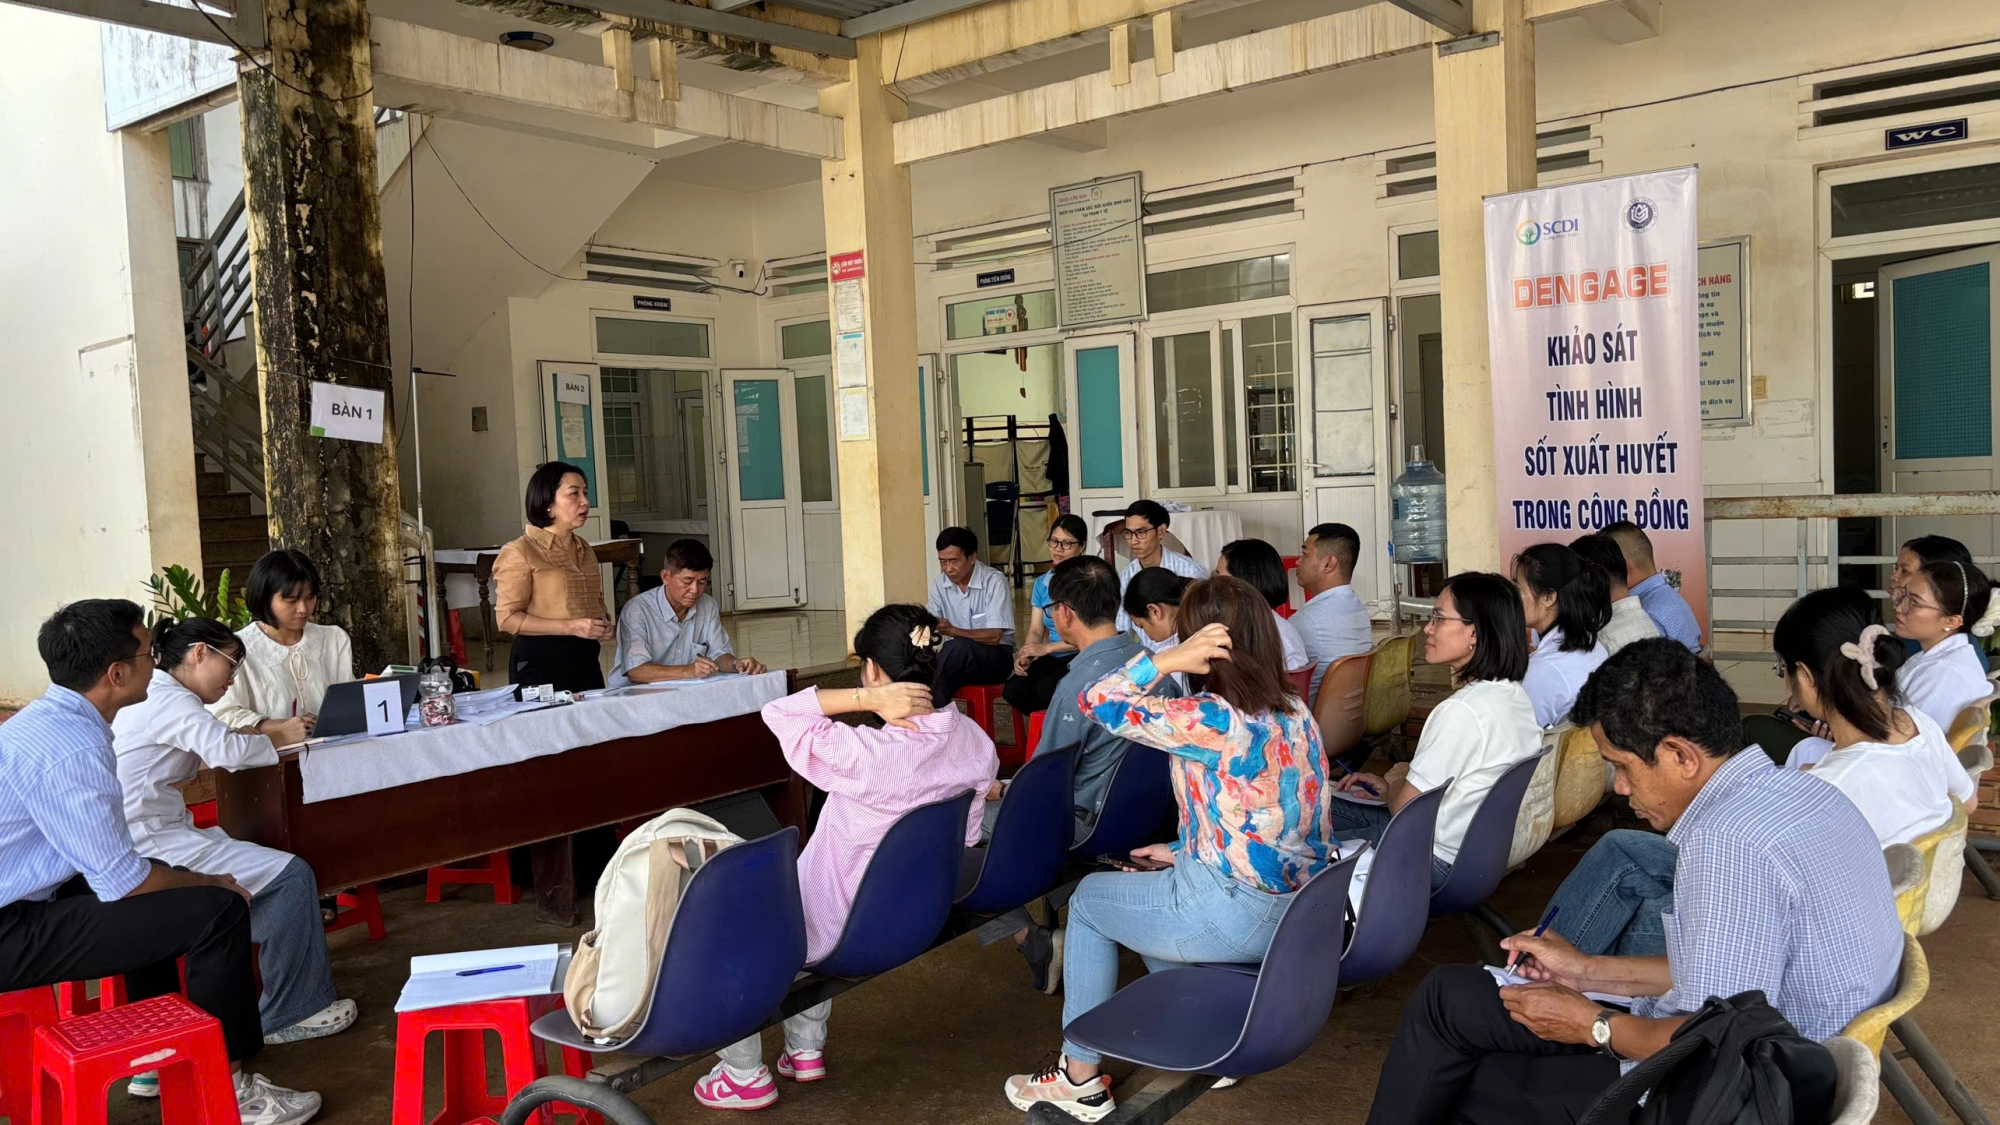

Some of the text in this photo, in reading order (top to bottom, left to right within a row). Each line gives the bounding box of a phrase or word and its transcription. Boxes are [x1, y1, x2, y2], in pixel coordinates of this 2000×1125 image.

[1895, 126, 1957, 142] WC
[1543, 218, 1578, 235] SCDI
[1514, 263, 1669, 309] DENGAGE
[1709, 274, 1732, 285] HÀNG
[1548, 323, 1637, 366] KHẢO SÁT
[566, 382, 579, 392] BÀN
[332, 402, 372, 420] BÀN 1
[1546, 380, 1642, 421] TÌNH HÌNH
[1525, 431, 1678, 476] SỐT XUẤT HUYẾT
[1513, 488, 1688, 532] TRONG CỘNG ĐỒNG
[377, 700, 388, 722] 1
